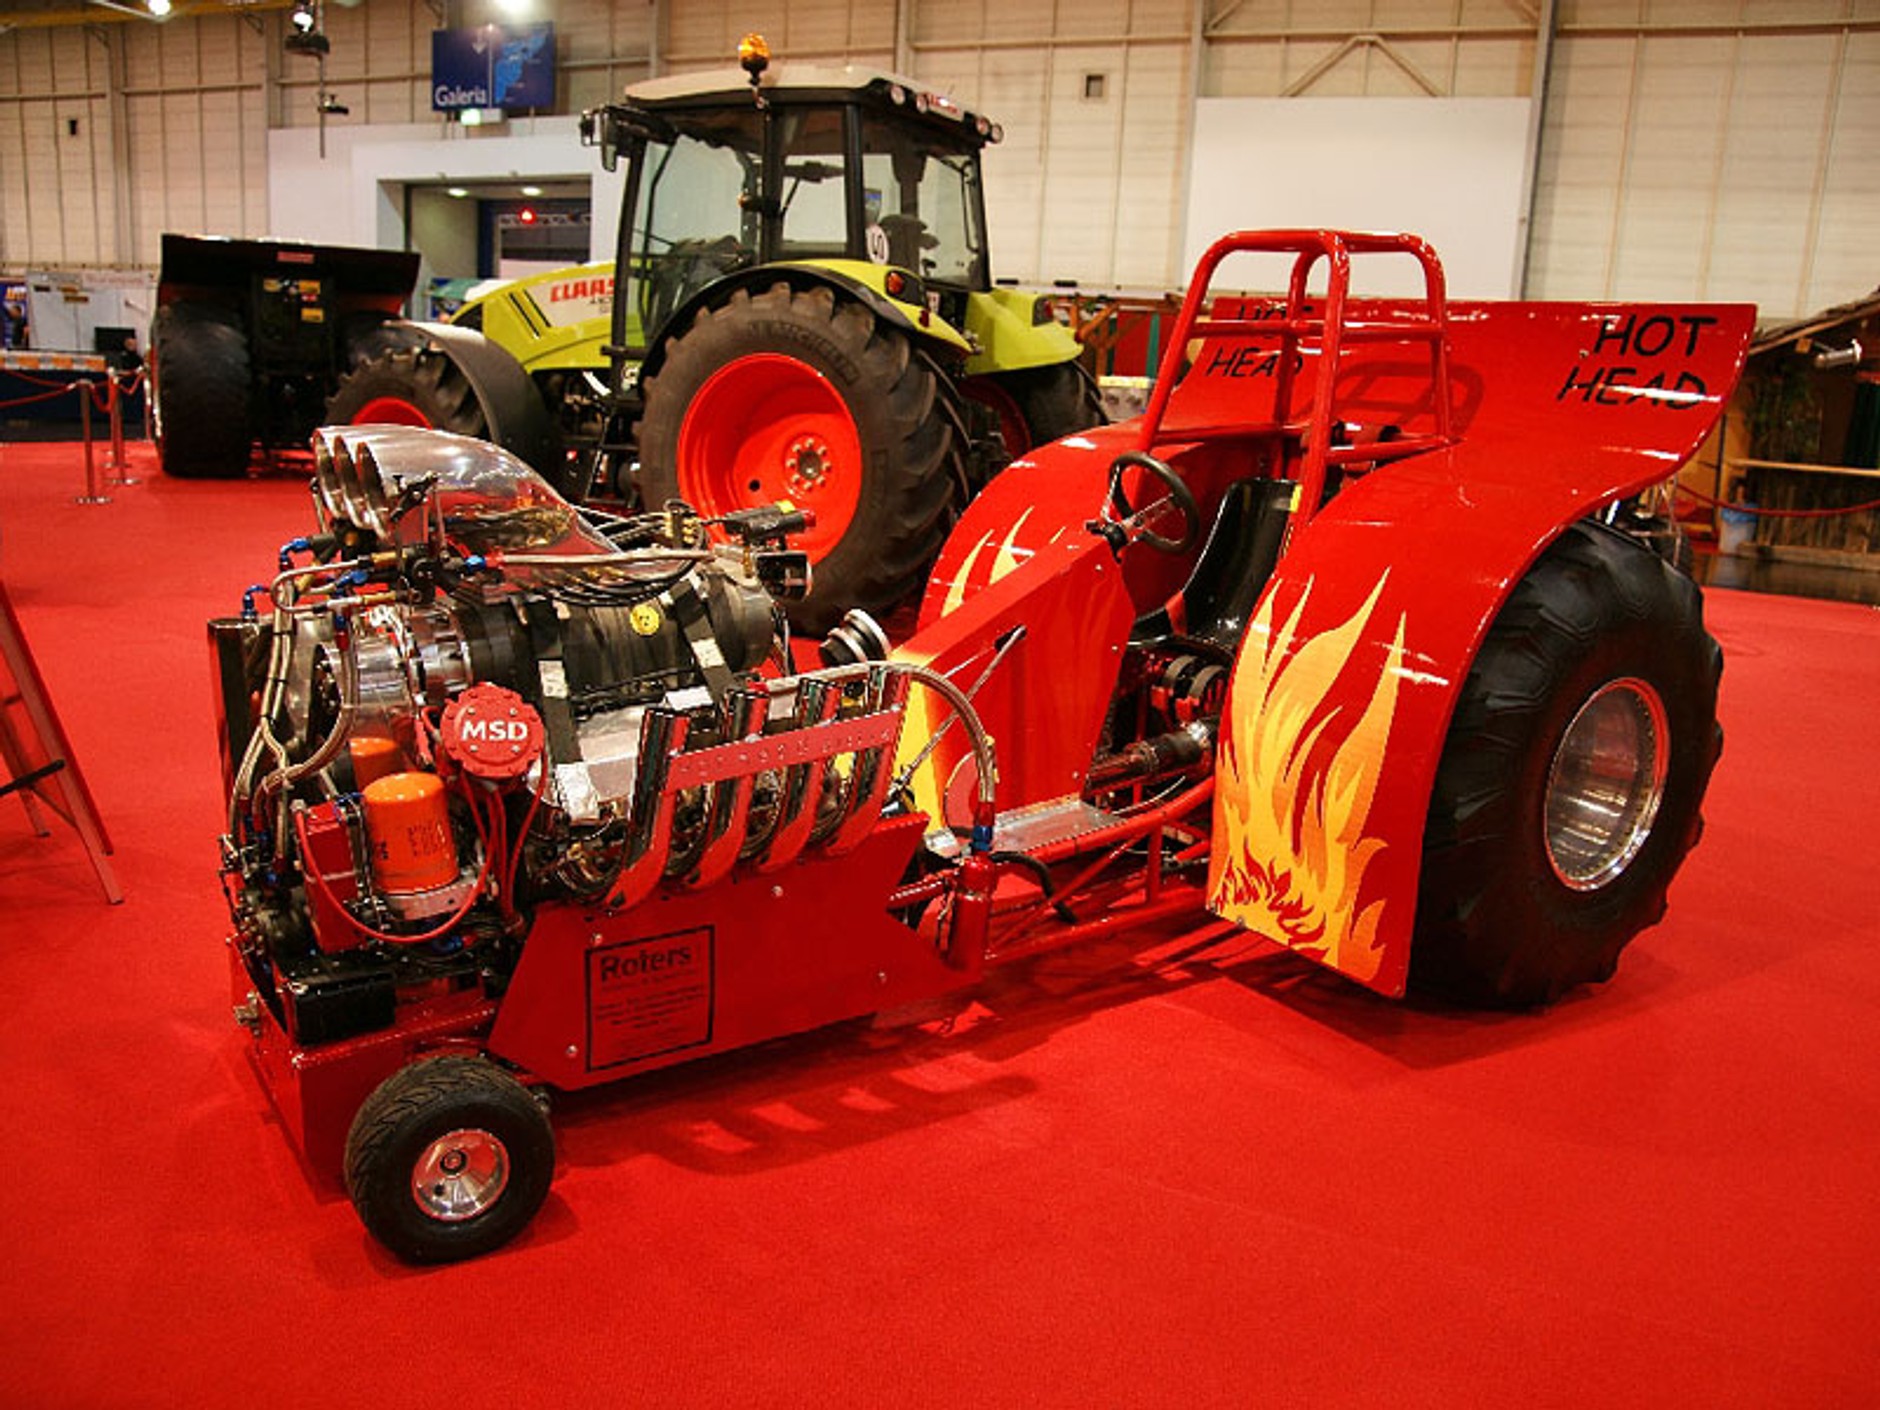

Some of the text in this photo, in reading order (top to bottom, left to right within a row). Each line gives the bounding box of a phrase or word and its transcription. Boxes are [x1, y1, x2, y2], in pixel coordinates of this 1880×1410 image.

[434, 84, 487, 106] Galeria
[871, 232, 885, 260] 40
[1593, 314, 1718, 357] HOT
[1556, 365, 1708, 410] HEAD
[462, 719, 528, 741] MSD
[601, 946, 692, 982] Roters
